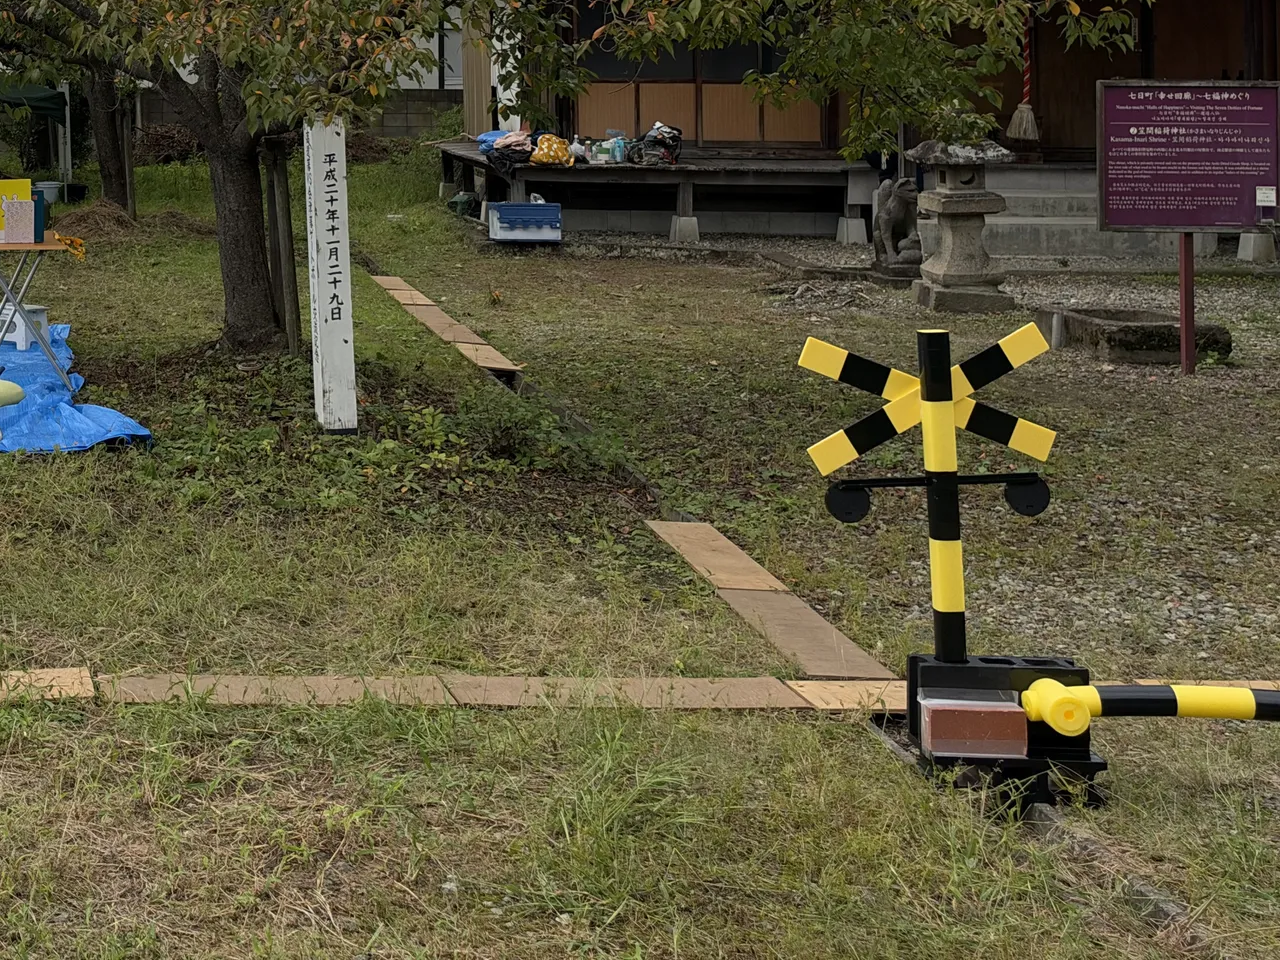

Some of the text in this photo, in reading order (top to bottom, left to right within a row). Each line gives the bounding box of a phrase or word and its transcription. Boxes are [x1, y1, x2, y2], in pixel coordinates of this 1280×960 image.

[323, 153, 344, 321] 平成二十年十一月二十九日
